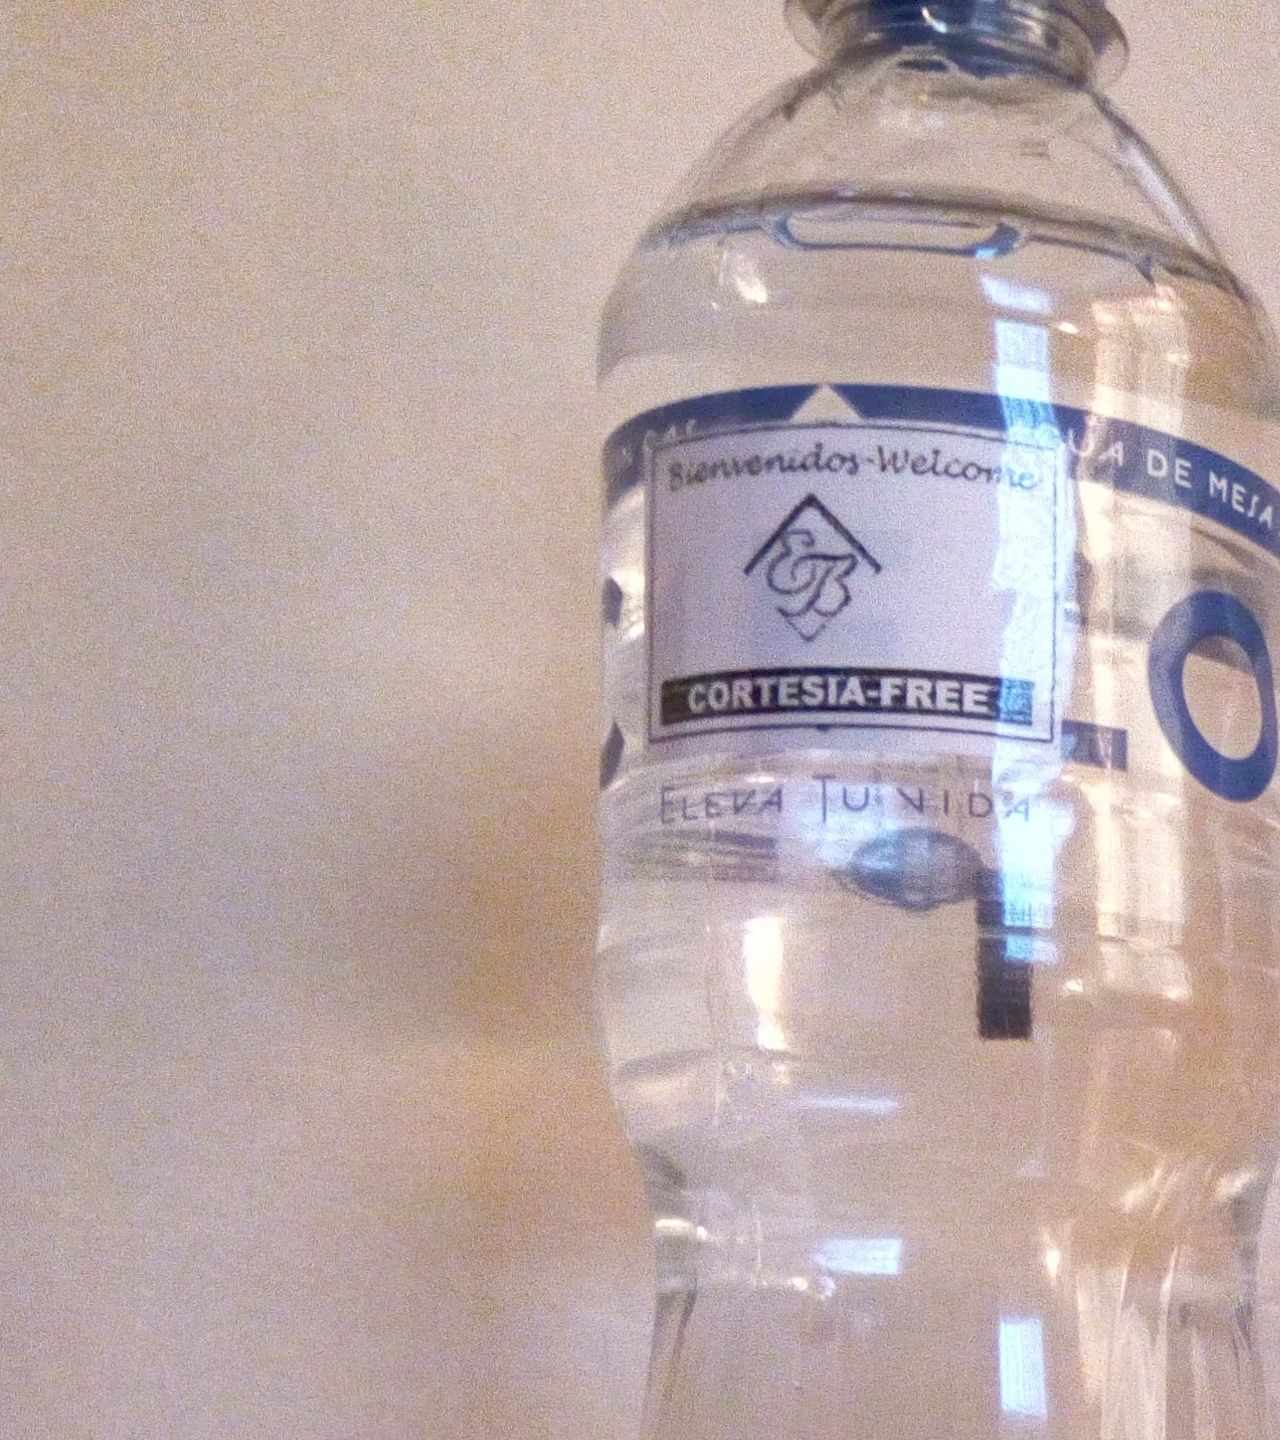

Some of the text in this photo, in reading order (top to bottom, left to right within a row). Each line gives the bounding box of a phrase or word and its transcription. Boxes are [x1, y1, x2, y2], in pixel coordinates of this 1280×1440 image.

[1147, 450, 1193, 489] DE
[1208, 470, 1280, 530] MESA
[687, 675, 990, 715] CORTESIA-FREE
[658, 784, 784, 824] ELEVA
